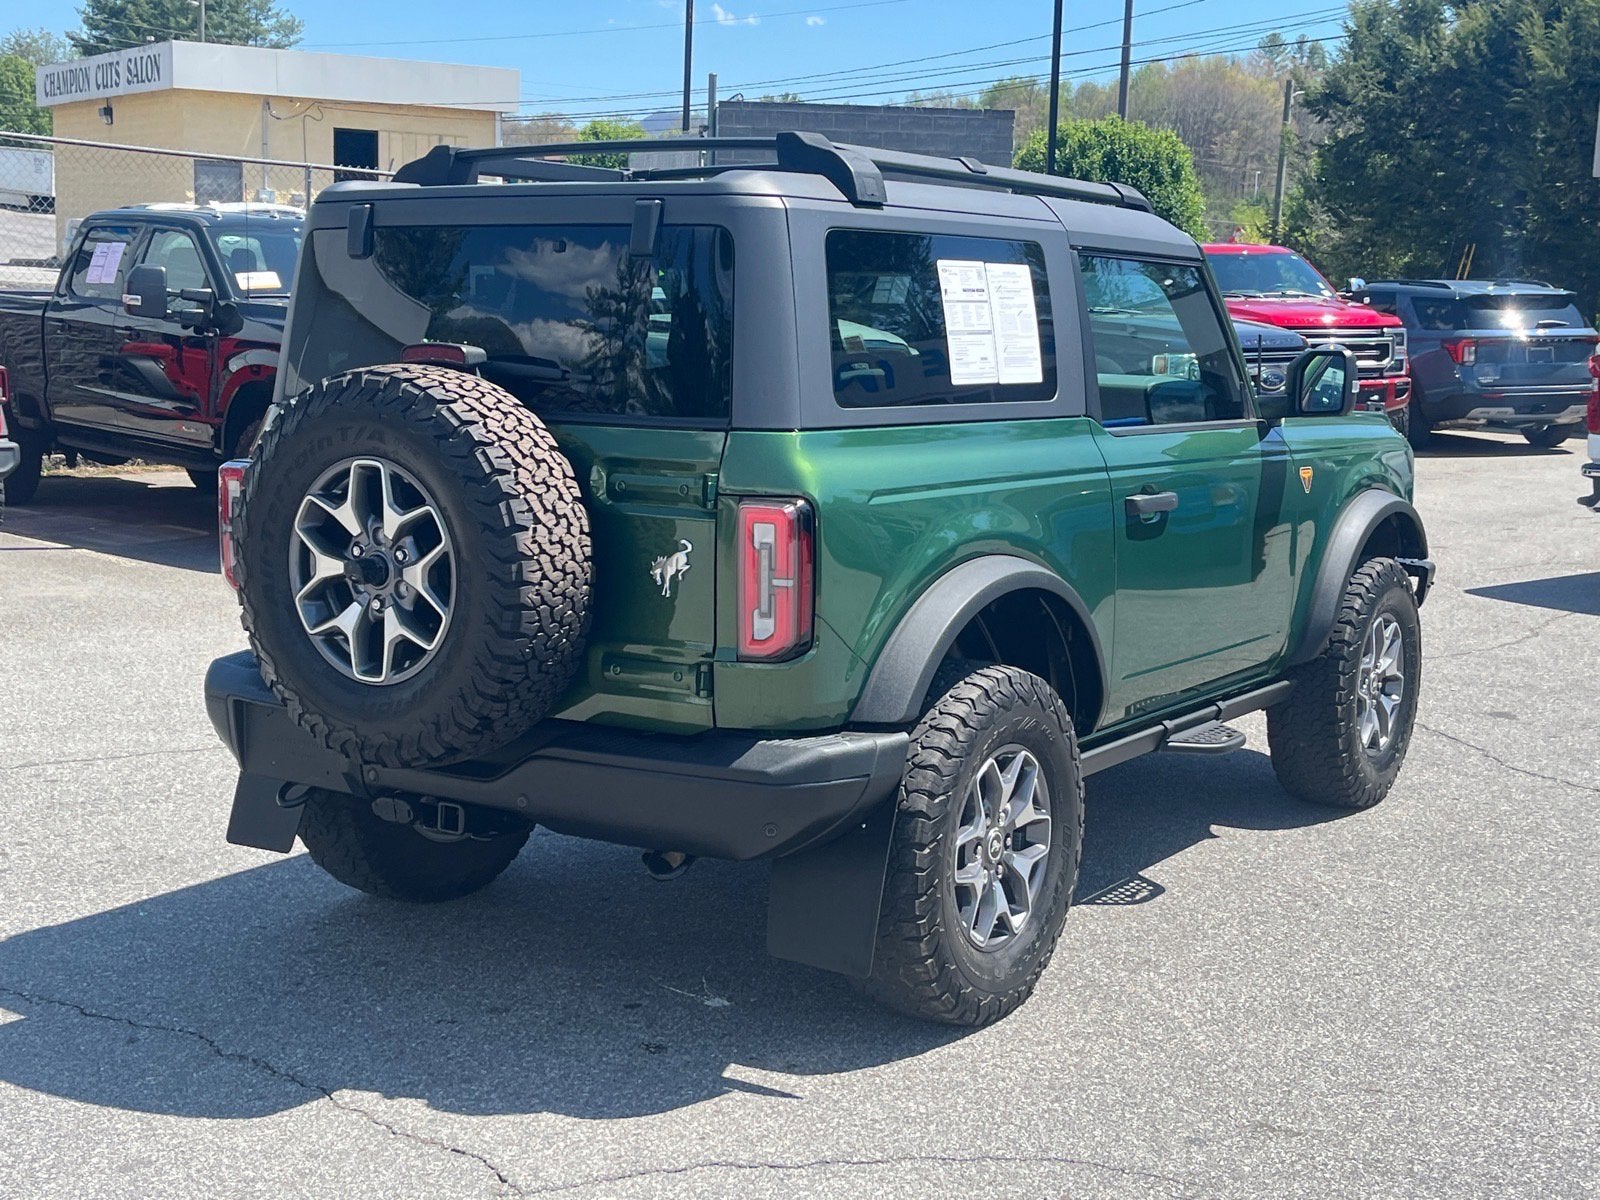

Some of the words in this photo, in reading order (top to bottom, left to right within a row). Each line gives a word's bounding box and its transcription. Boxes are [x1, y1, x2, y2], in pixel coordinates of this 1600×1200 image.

[44, 66, 91, 98] CHAMPION
[95, 60, 121, 91] CUTS
[126, 53, 161, 86] SALON
